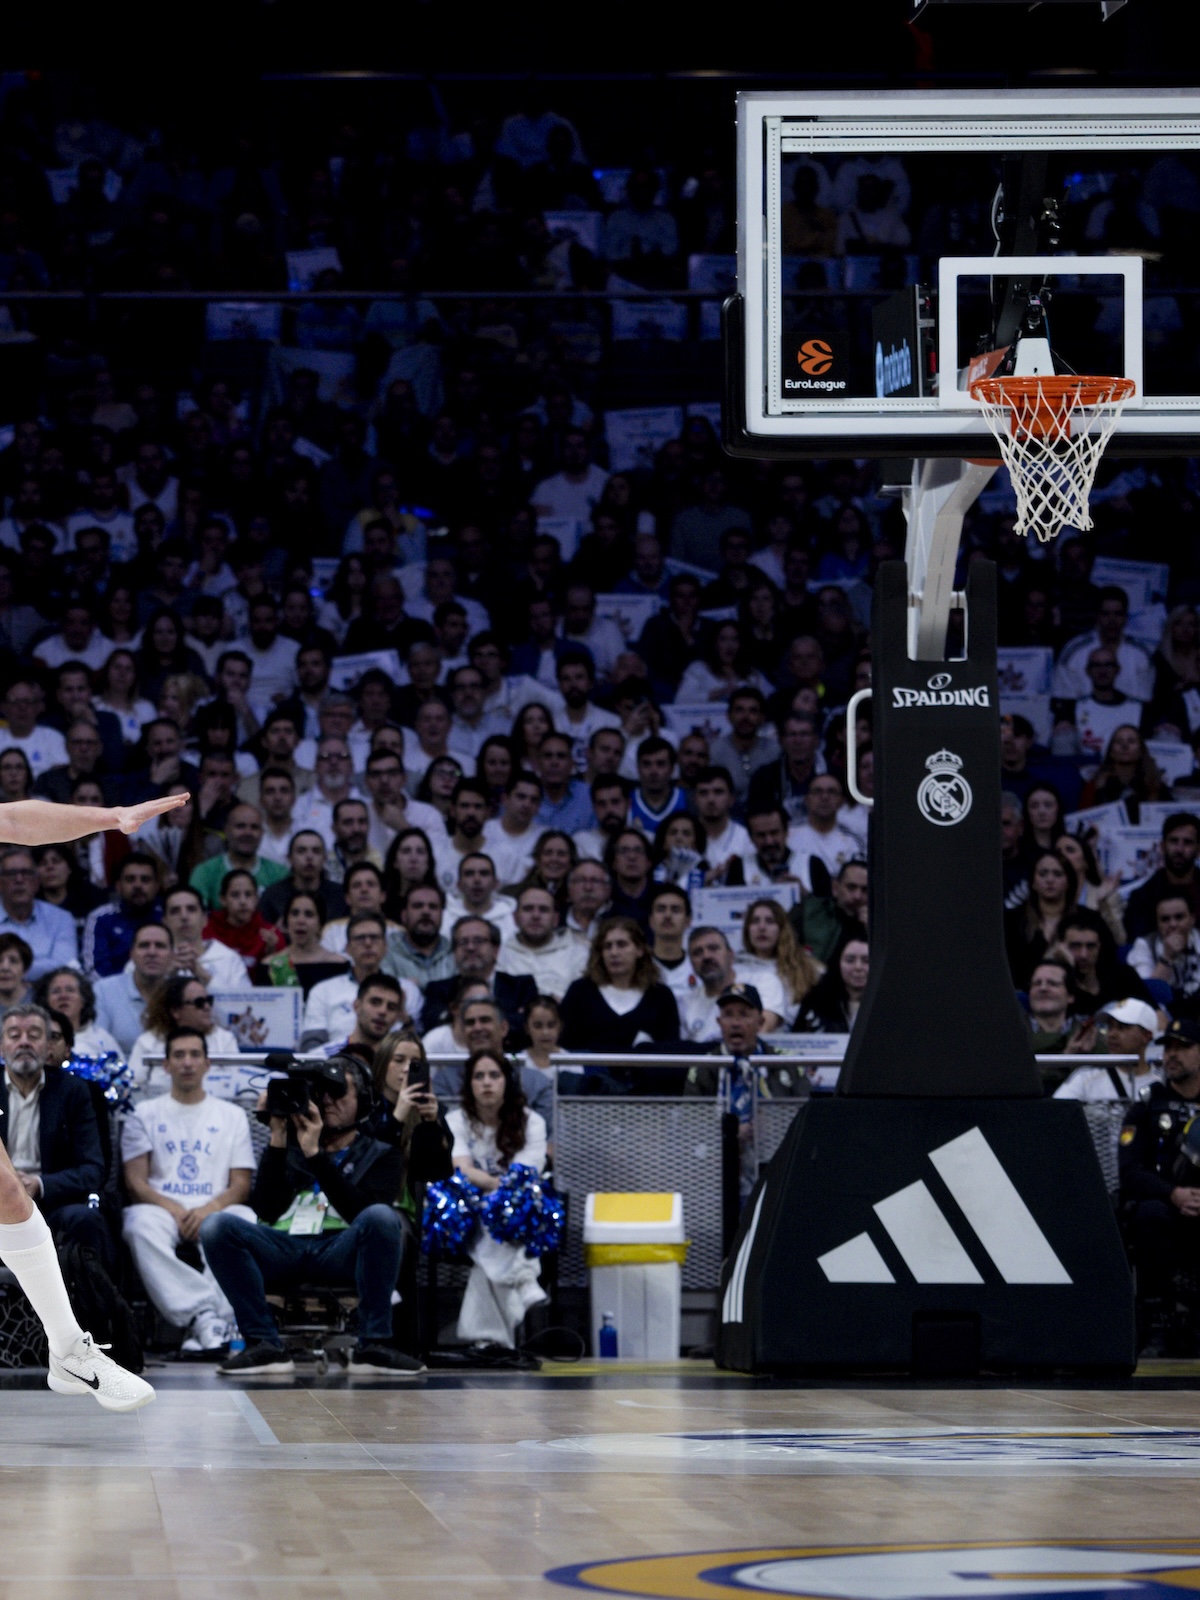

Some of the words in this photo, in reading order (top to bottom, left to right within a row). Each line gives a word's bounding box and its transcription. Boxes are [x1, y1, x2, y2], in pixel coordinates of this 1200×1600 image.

[785, 379, 846, 391] EuroLeague
[892, 686, 990, 708] SPALDING
[166, 1140, 211, 1155] REAL
[162, 1182, 212, 1195] MADRID
